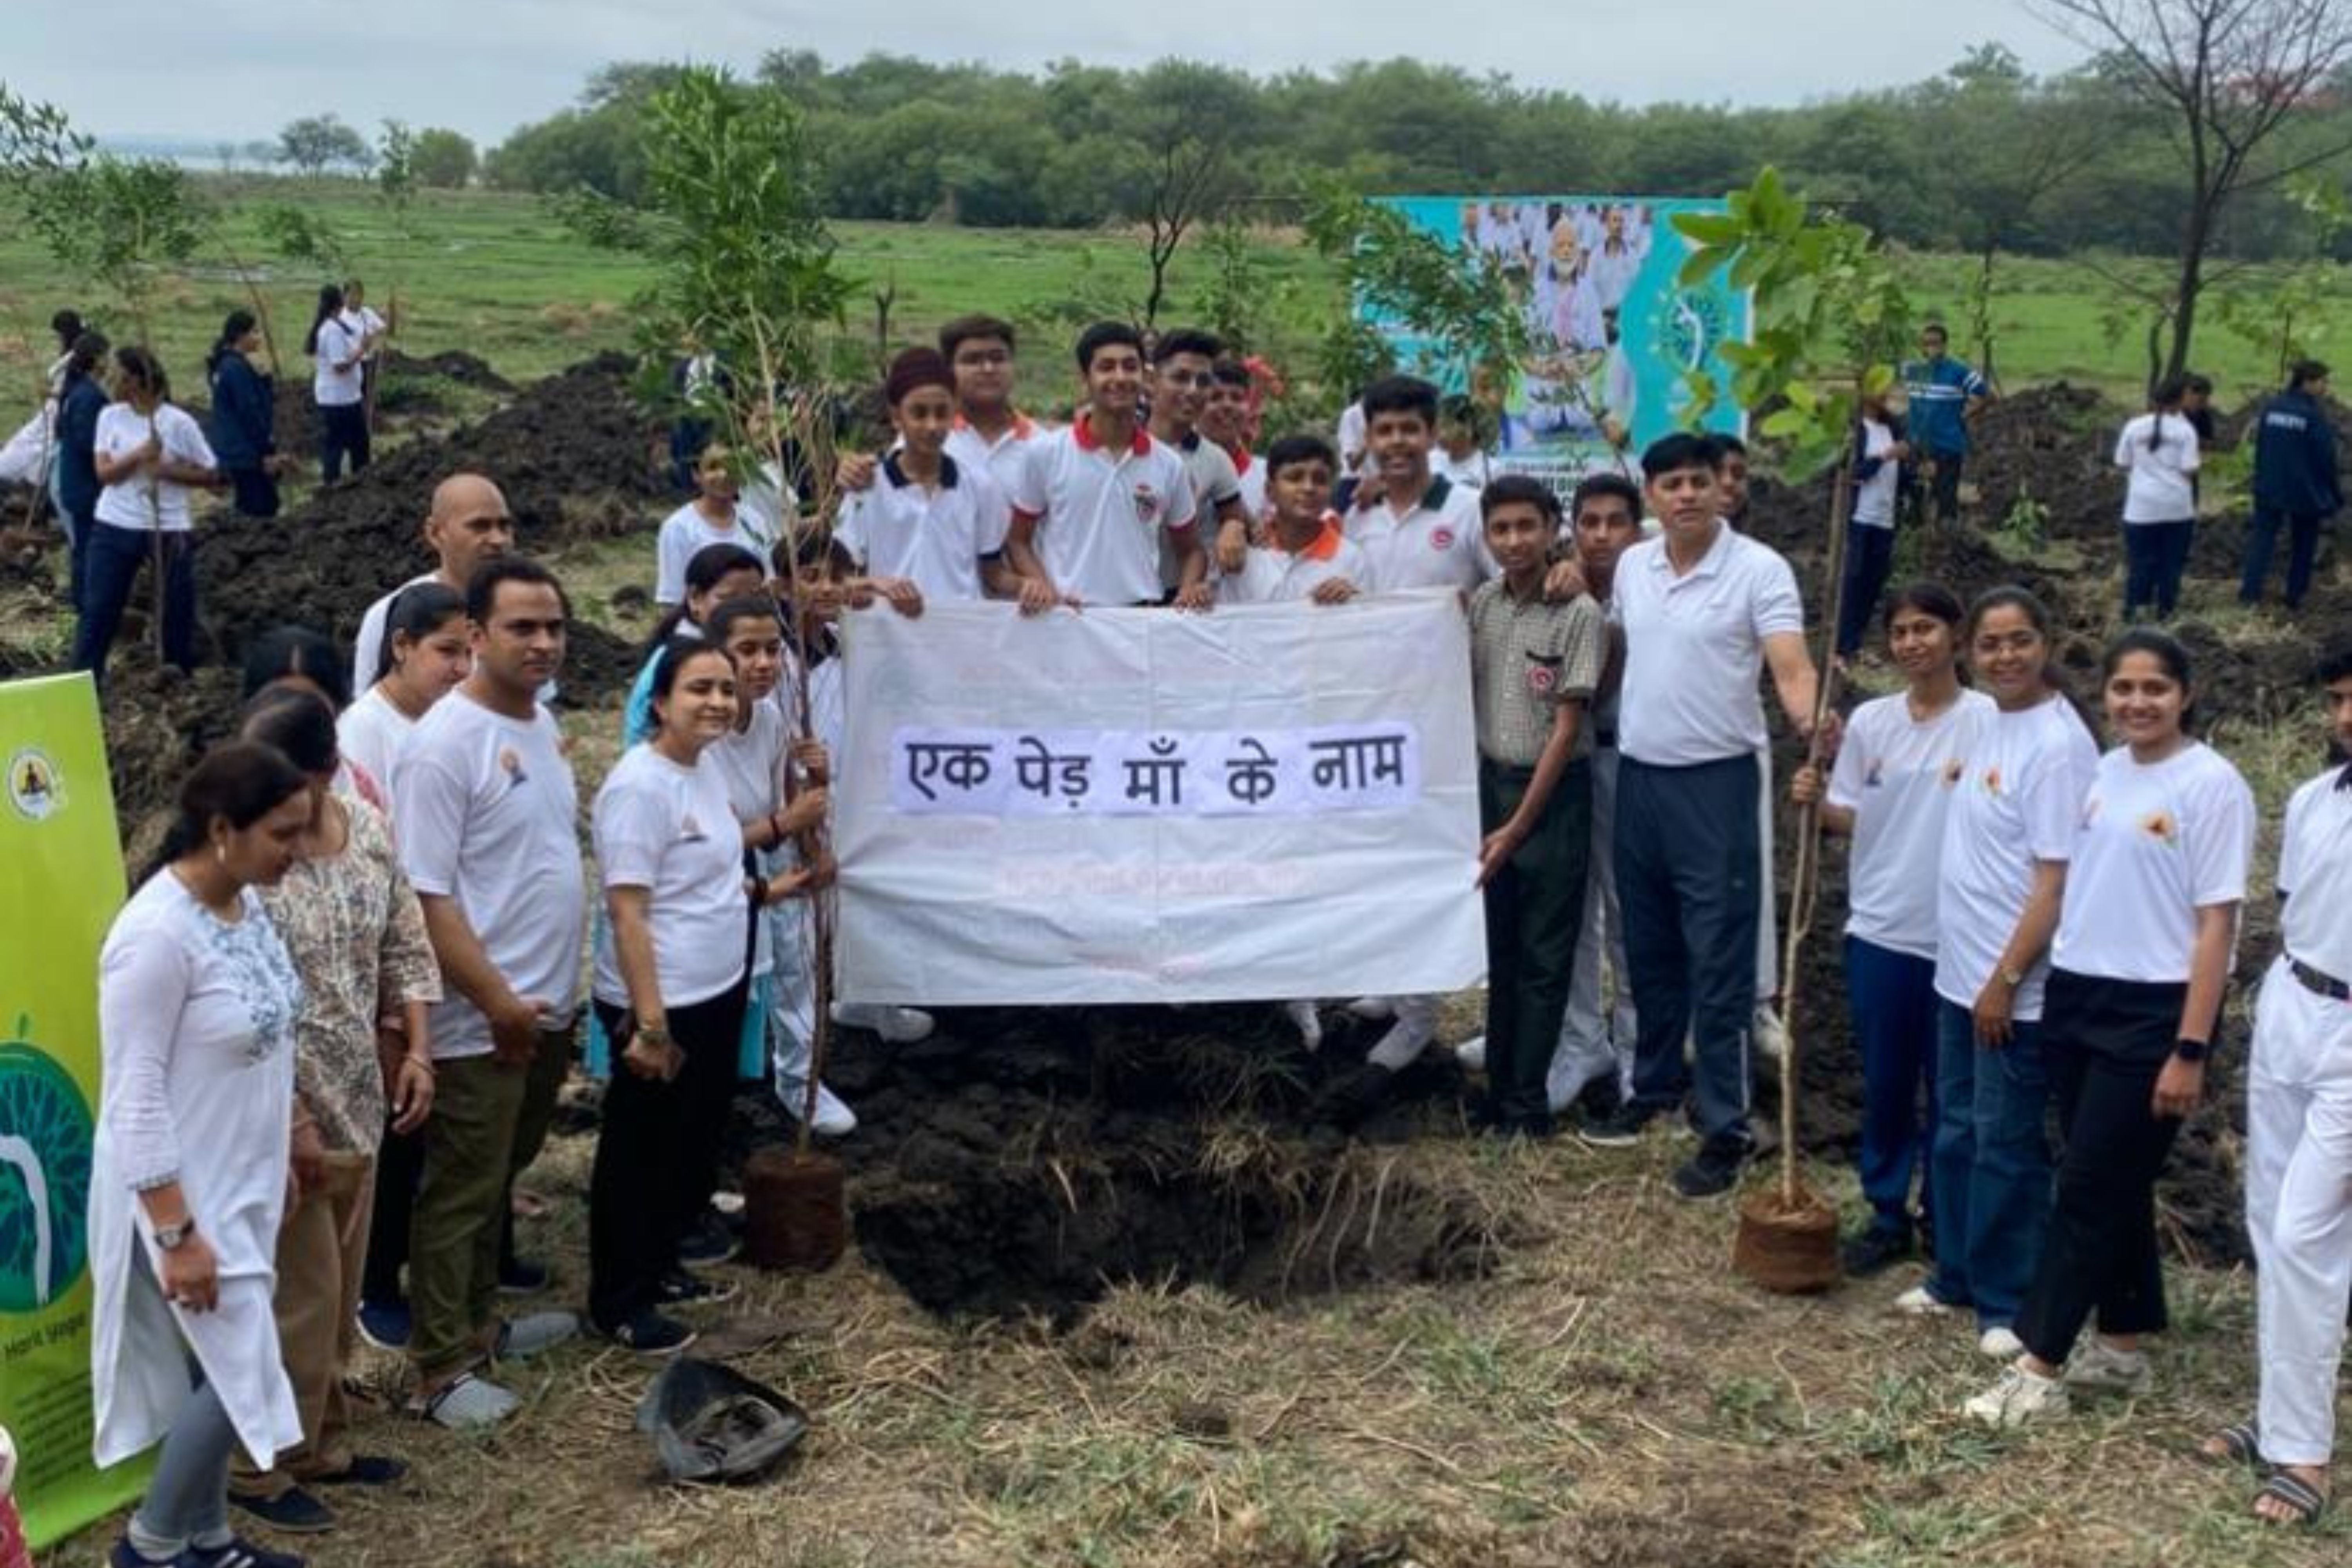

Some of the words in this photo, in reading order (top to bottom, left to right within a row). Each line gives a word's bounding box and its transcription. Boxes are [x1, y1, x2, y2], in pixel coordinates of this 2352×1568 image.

[904, 742, 993, 801] एक
[1014, 736, 1091, 807] पेड़
[1123, 737, 1186, 804] माँ
[1226, 739, 1278, 804] के
[1309, 735, 1405, 789] नाम
